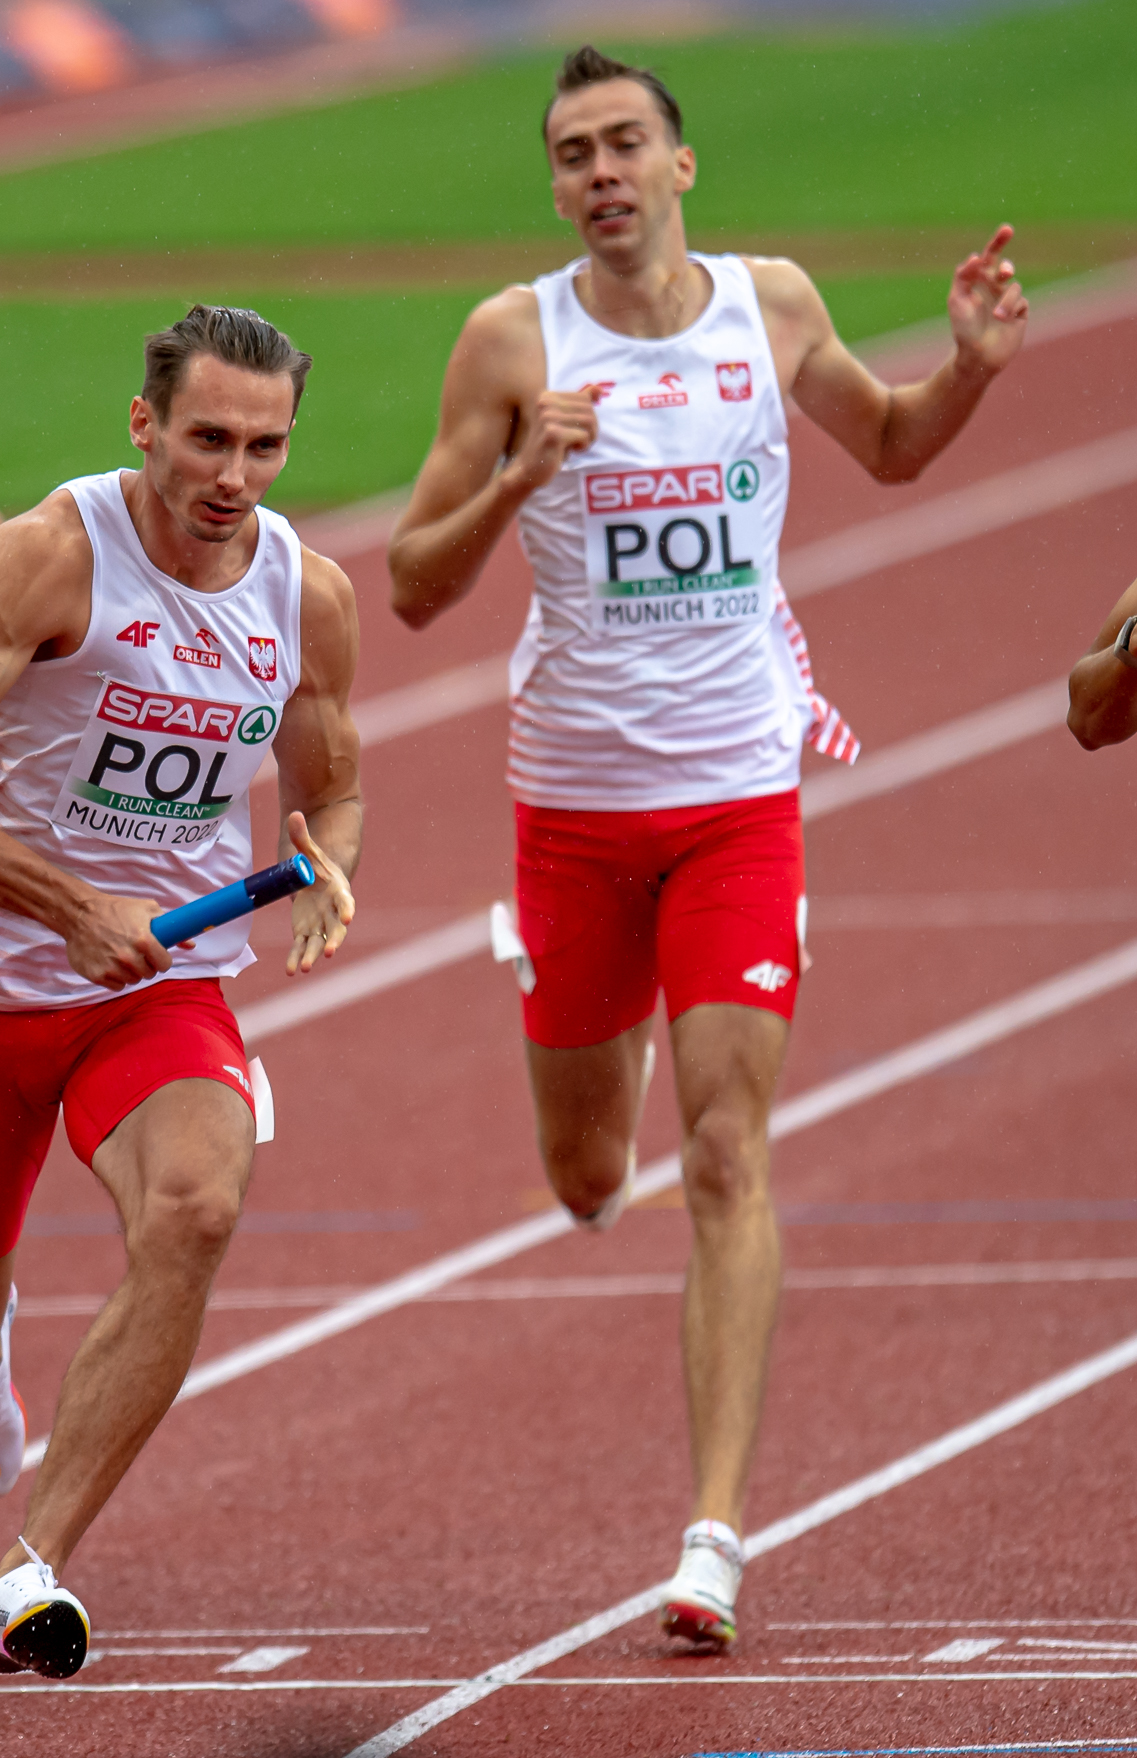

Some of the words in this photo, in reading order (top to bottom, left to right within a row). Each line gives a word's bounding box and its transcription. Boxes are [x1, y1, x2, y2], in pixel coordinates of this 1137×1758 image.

[589, 469, 721, 509] SPAR
[605, 515, 752, 582] POL
[602, 598, 704, 625] MUNICH
[713, 593, 760, 619] 2022
[116, 620, 161, 648] 4F
[175, 647, 219, 667] ORLEN
[104, 689, 235, 737] SPAR
[87, 732, 233, 804] POL
[66, 801, 167, 843] MUNICH
[171, 820, 219, 844] 2022
[117, 796, 153, 813] RUN
